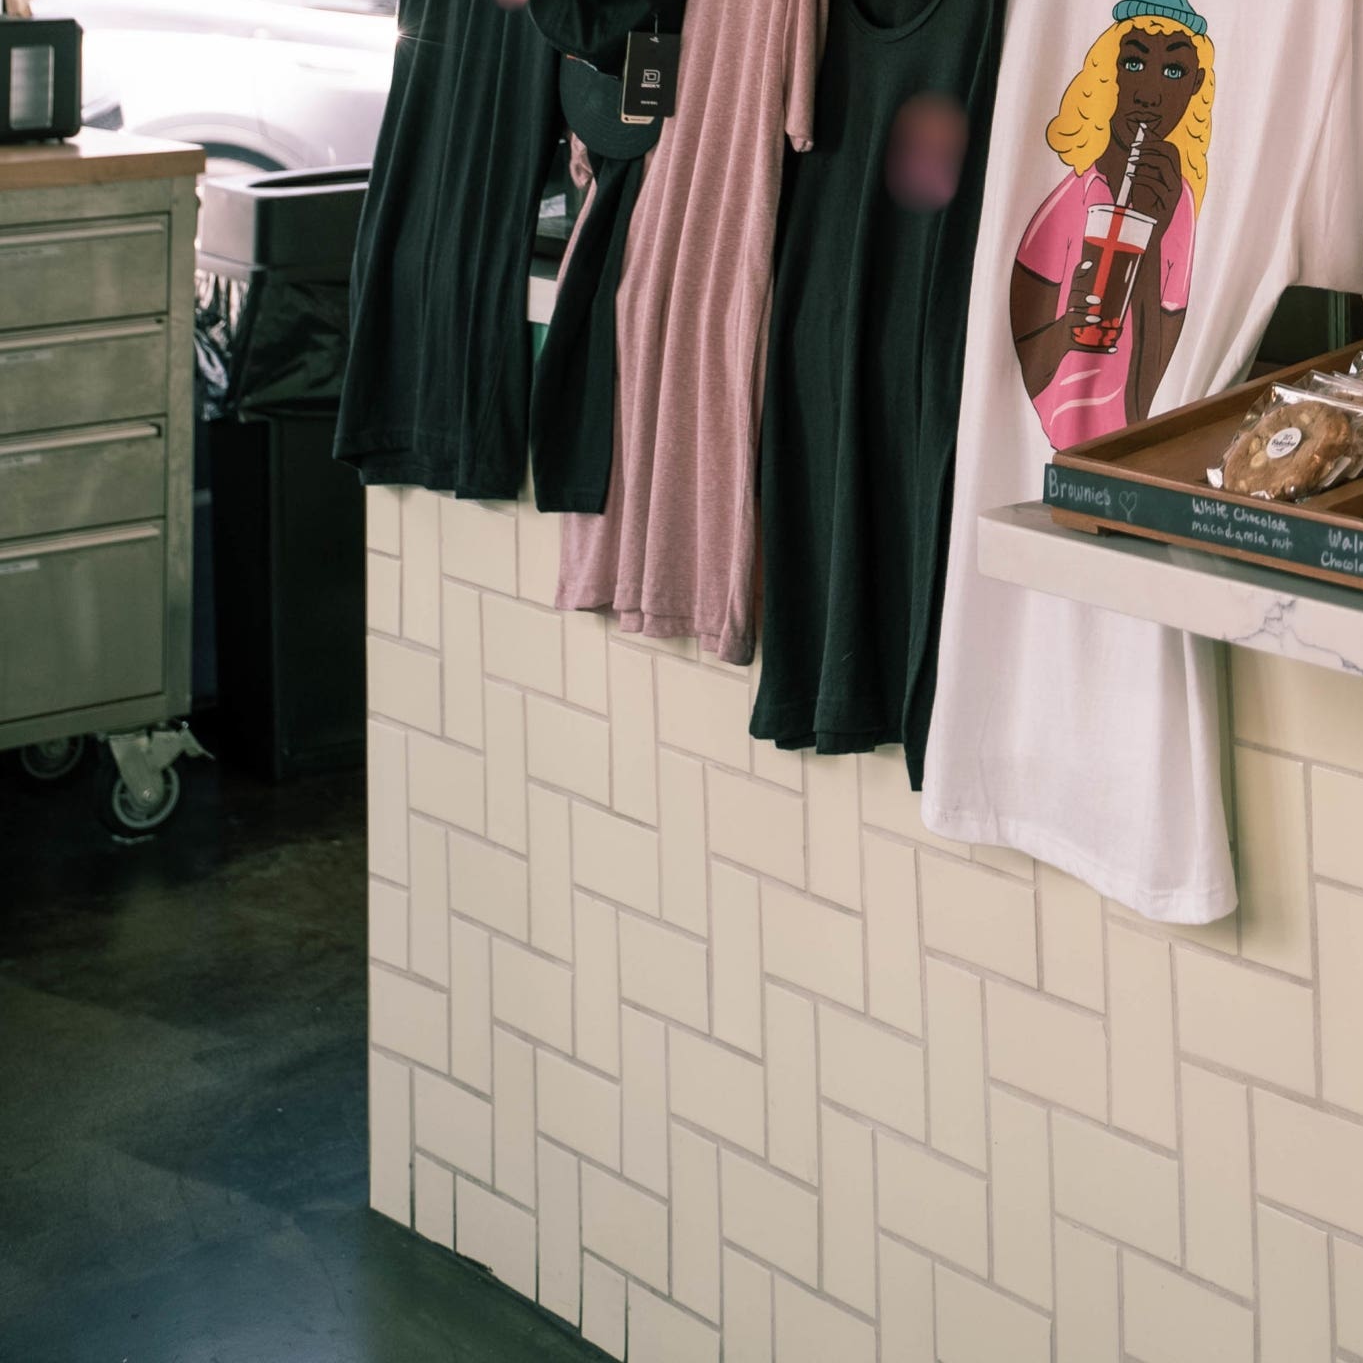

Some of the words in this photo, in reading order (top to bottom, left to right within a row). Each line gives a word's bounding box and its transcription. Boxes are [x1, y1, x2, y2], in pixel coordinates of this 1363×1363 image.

[1049, 469, 1112, 507] Brownies
[1191, 497, 1228, 520] White
[1233, 507, 1291, 533] Chocolate
[1191, 520, 1268, 545] macadamia
[1271, 537, 1294, 551] nut
